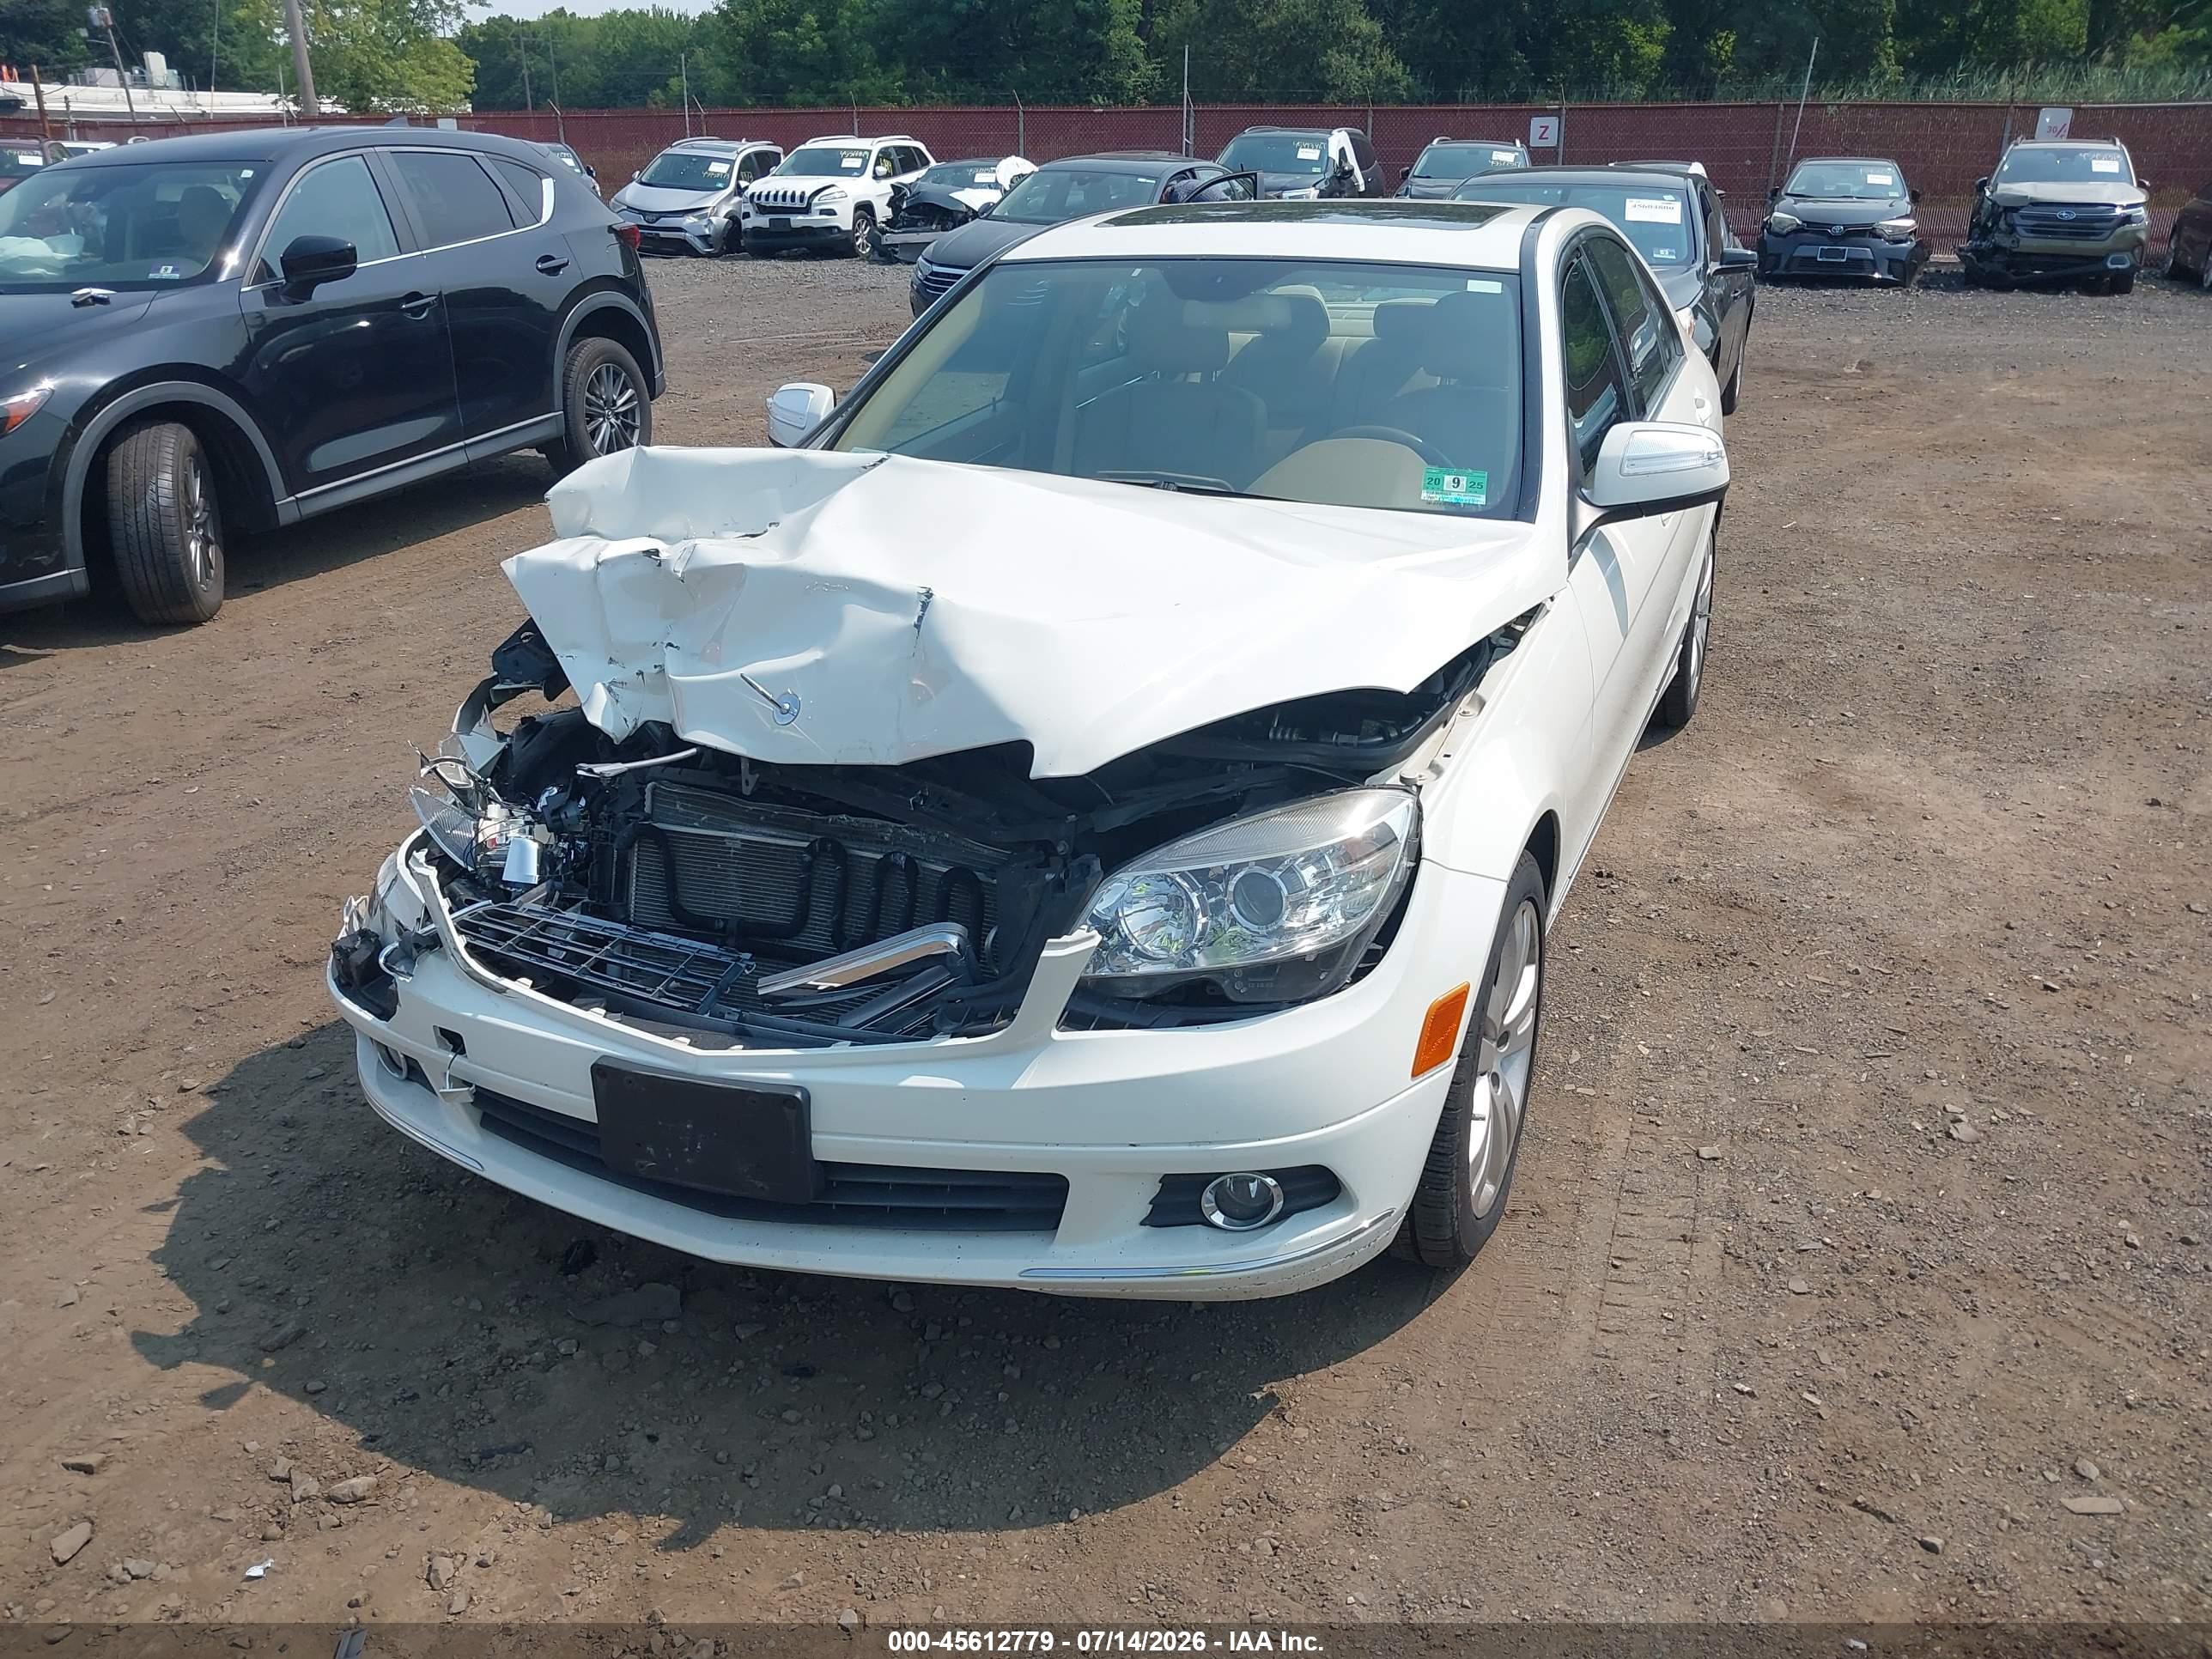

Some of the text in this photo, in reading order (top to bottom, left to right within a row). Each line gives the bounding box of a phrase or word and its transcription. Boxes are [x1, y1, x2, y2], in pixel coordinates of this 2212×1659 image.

[1539, 125, 1549, 140] Z
[1427, 477, 1484, 489] 20 9 25
